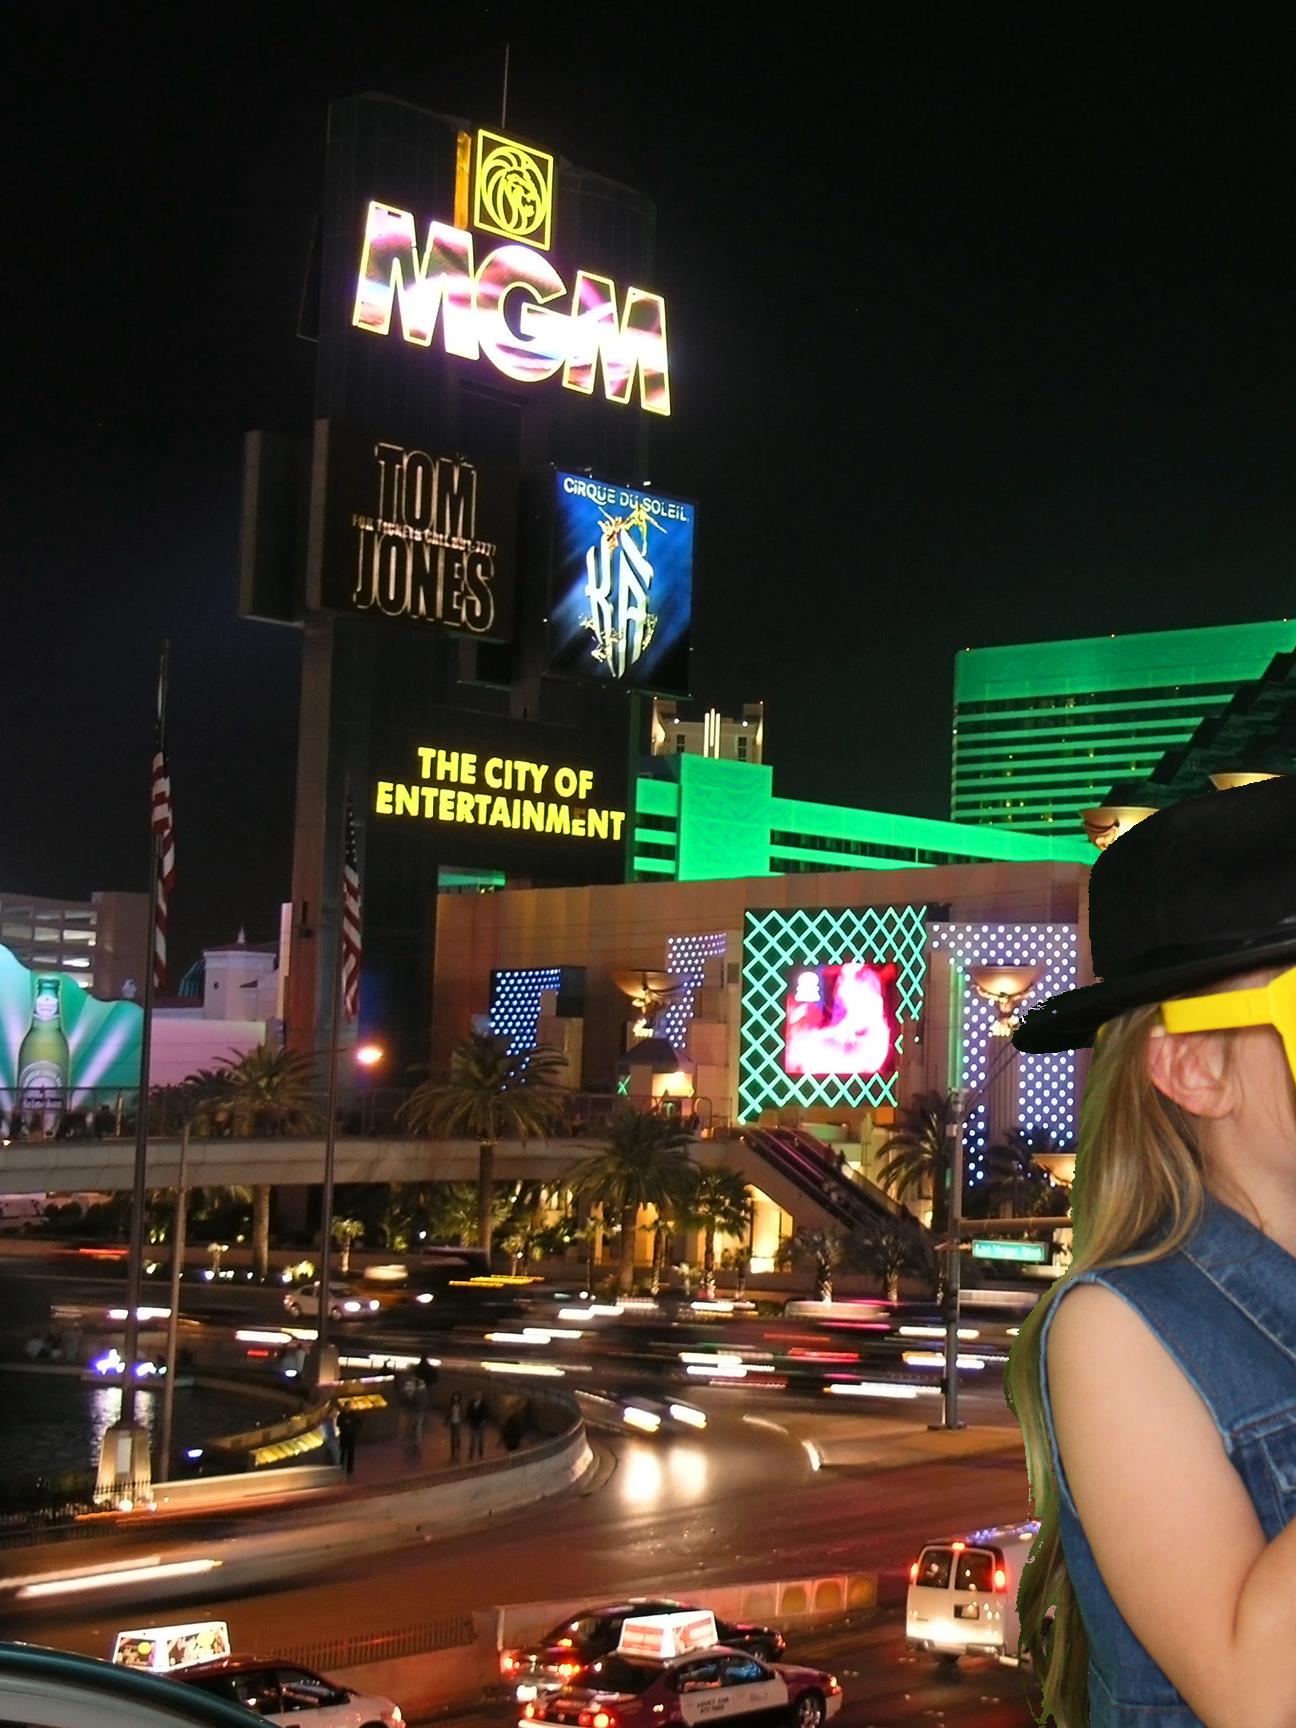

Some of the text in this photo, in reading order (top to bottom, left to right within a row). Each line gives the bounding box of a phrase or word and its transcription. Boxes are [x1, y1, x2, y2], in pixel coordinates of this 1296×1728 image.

[353, 201, 670, 416] MGM
[374, 442, 477, 541] TOM
[563, 477, 616, 505] CIRQUE
[620, 491, 640, 508] DU
[353, 530, 495, 632] JONES
[376, 781, 626, 841] ENTERTAINMENT
[417, 746, 594, 800] THE CITY OF
